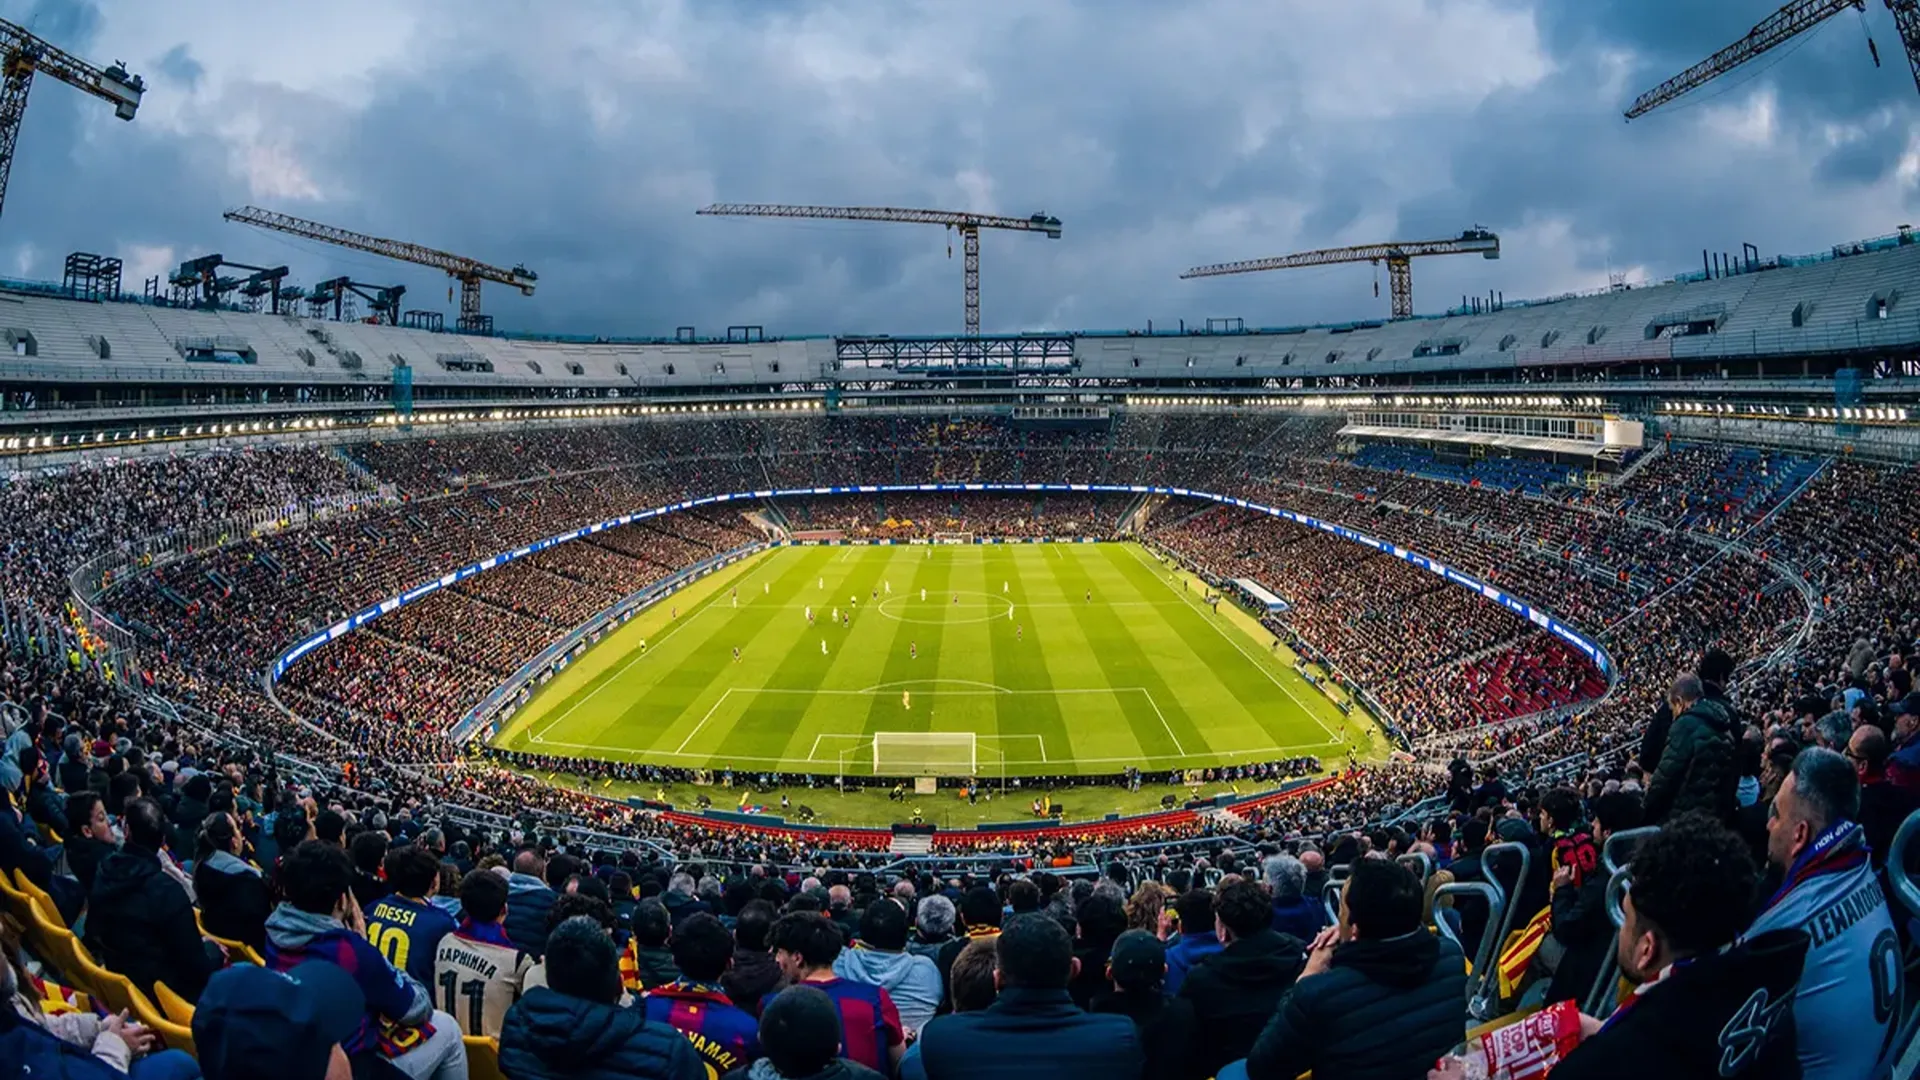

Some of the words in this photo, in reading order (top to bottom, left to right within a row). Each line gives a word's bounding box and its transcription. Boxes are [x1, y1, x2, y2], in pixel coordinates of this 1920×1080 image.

[374, 903, 417, 926] MESSI
[368, 922, 410, 971] 10
[439, 948, 498, 980] RAPHINHA
[439, 969, 486, 1037] 11
[1869, 928, 1904, 1062] 9
[688, 1031, 737, 1069] YAMAL
[1510, 1024, 1525, 1052] TOP
